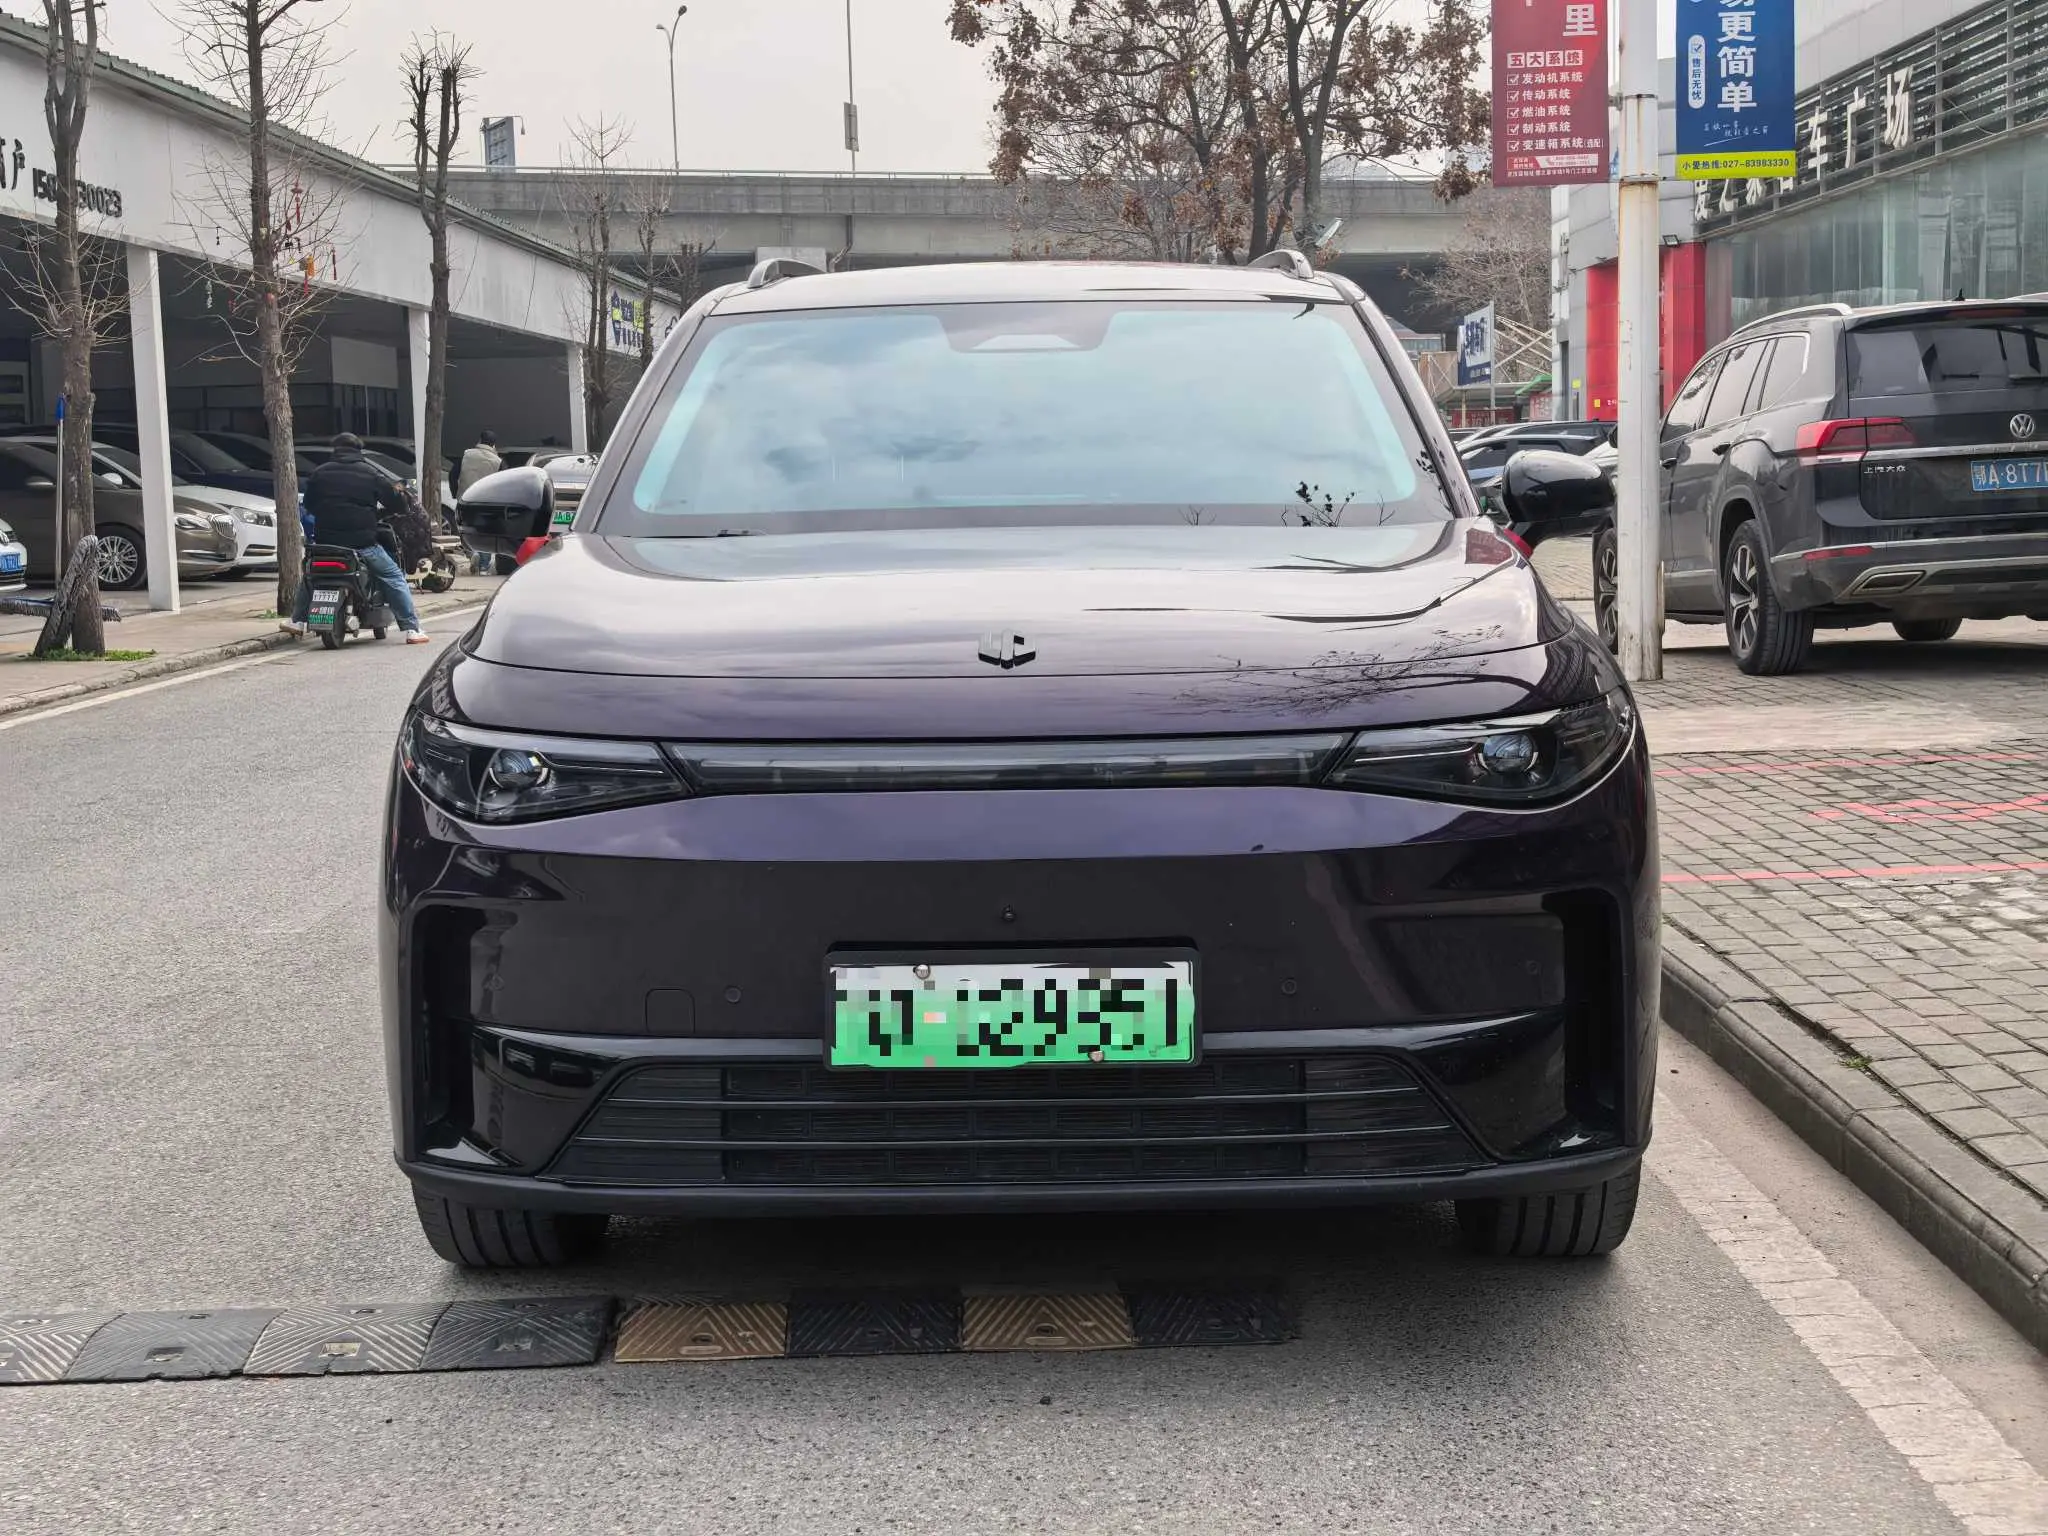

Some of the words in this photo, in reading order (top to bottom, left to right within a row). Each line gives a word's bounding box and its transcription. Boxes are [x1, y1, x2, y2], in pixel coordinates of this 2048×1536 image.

[1563, 4, 1598, 36] 里
[1508, 51, 1583, 68] 五大系统
[1717, 0, 1757, 112] 更简单
[1522, 72, 1583, 85] 发动机系统
[1522, 88, 1571, 101] 传动系统
[1522, 105, 1571, 118] 燃油系统
[1522, 121, 1571, 134] 制动系统
